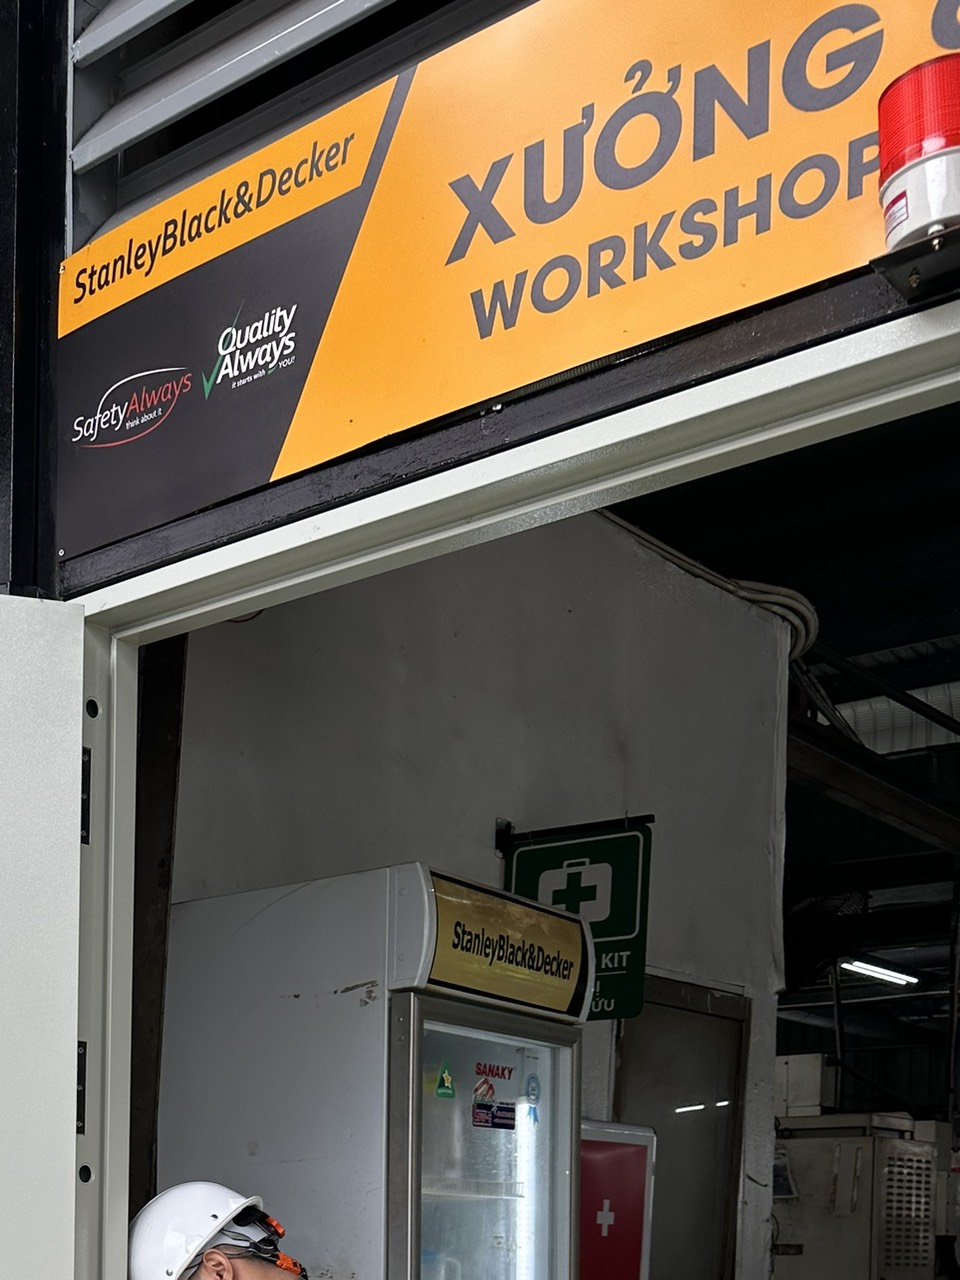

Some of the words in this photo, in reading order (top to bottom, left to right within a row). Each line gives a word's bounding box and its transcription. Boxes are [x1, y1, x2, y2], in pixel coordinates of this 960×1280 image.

[445, 3, 884, 266] XƯỞNG
[73, 132, 355, 304] StanleyBlack&Decker
[469, 129, 879, 340] WORKSHOP
[216, 332, 296, 384] Always
[218, 304, 297, 356] Quality
[72, 373, 192, 442] SafetyAlways
[140, 409, 158, 424] about
[452, 920, 574, 980] StanleyBlack&Decker
[601, 951, 631, 968] KIT
[475, 1062, 514, 1081] SANAKY
